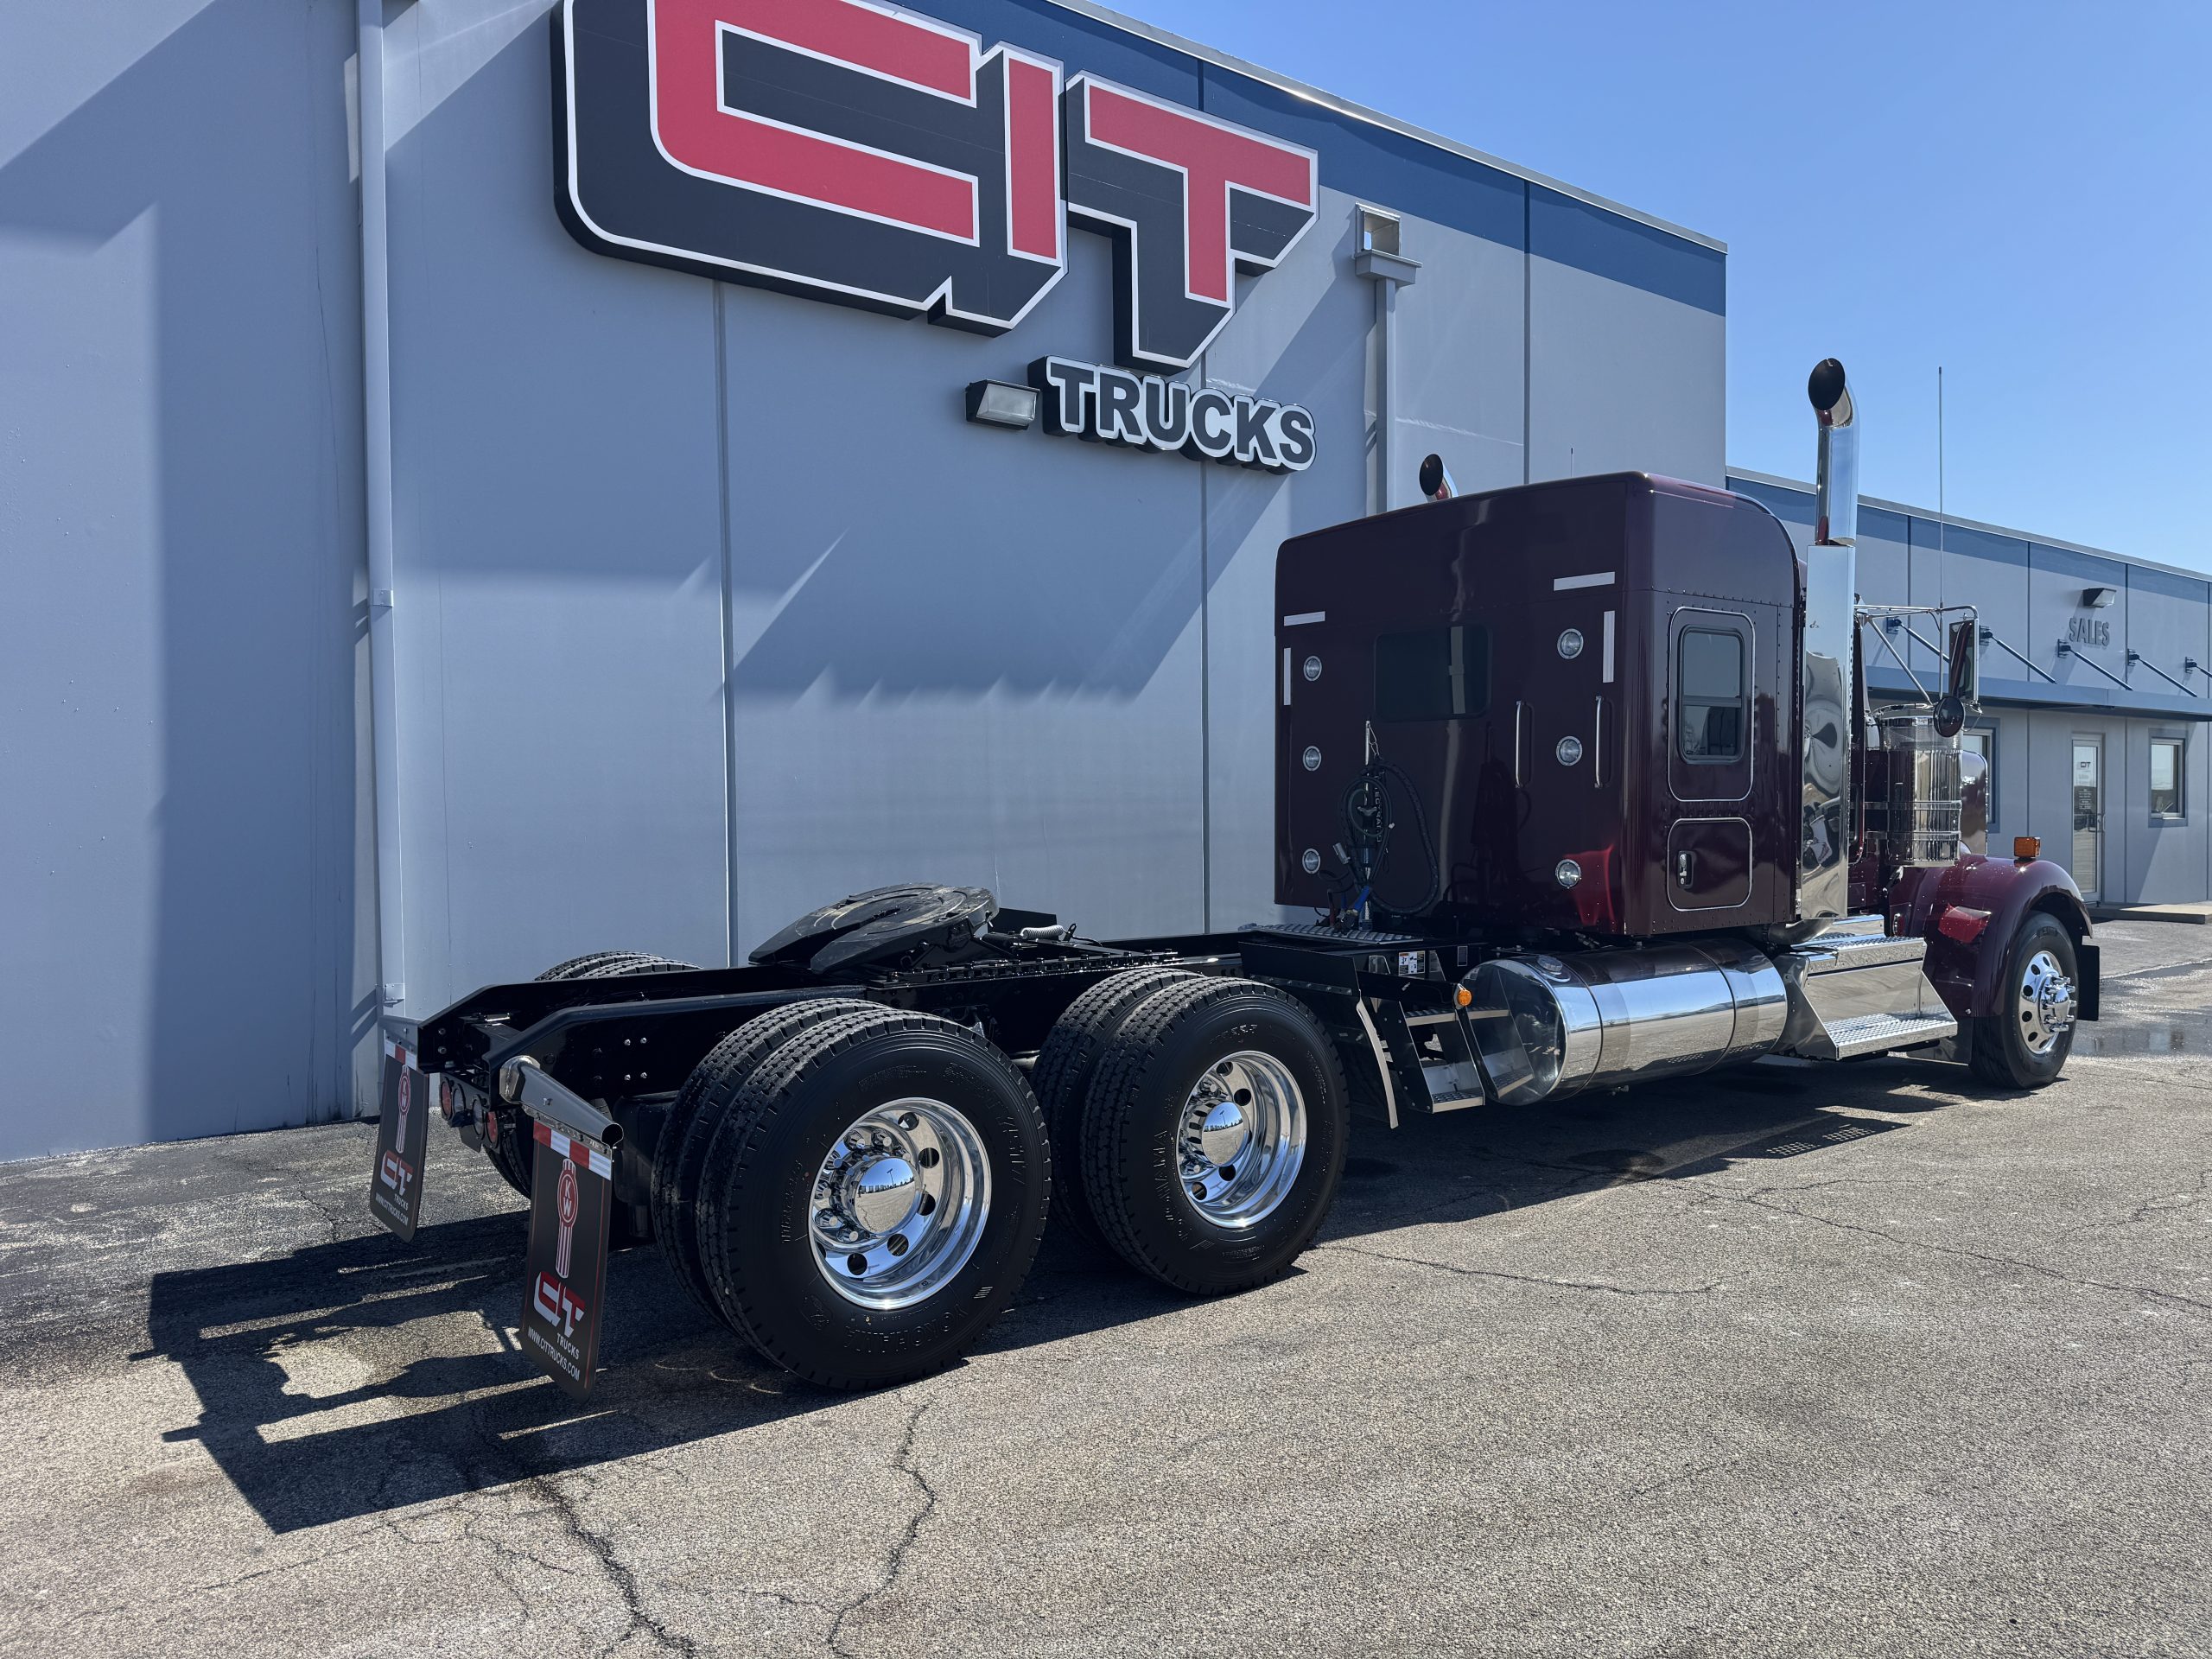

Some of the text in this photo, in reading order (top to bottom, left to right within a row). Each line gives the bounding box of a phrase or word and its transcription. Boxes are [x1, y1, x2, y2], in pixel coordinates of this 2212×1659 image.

[567, 0, 1319, 370] CIT
[1047, 359, 1315, 468] TRUCKS
[2069, 617, 2110, 647] SALES
[381, 1149, 414, 1196] CIT
[394, 1193, 409, 1211] TRUCKS
[563, 1179, 572, 1217] KW
[534, 1271, 586, 1338] CIT
[528, 1325, 580, 1382] WWW.CITTRUCKS.COM
[556, 1332, 580, 1360] TRUCKS
